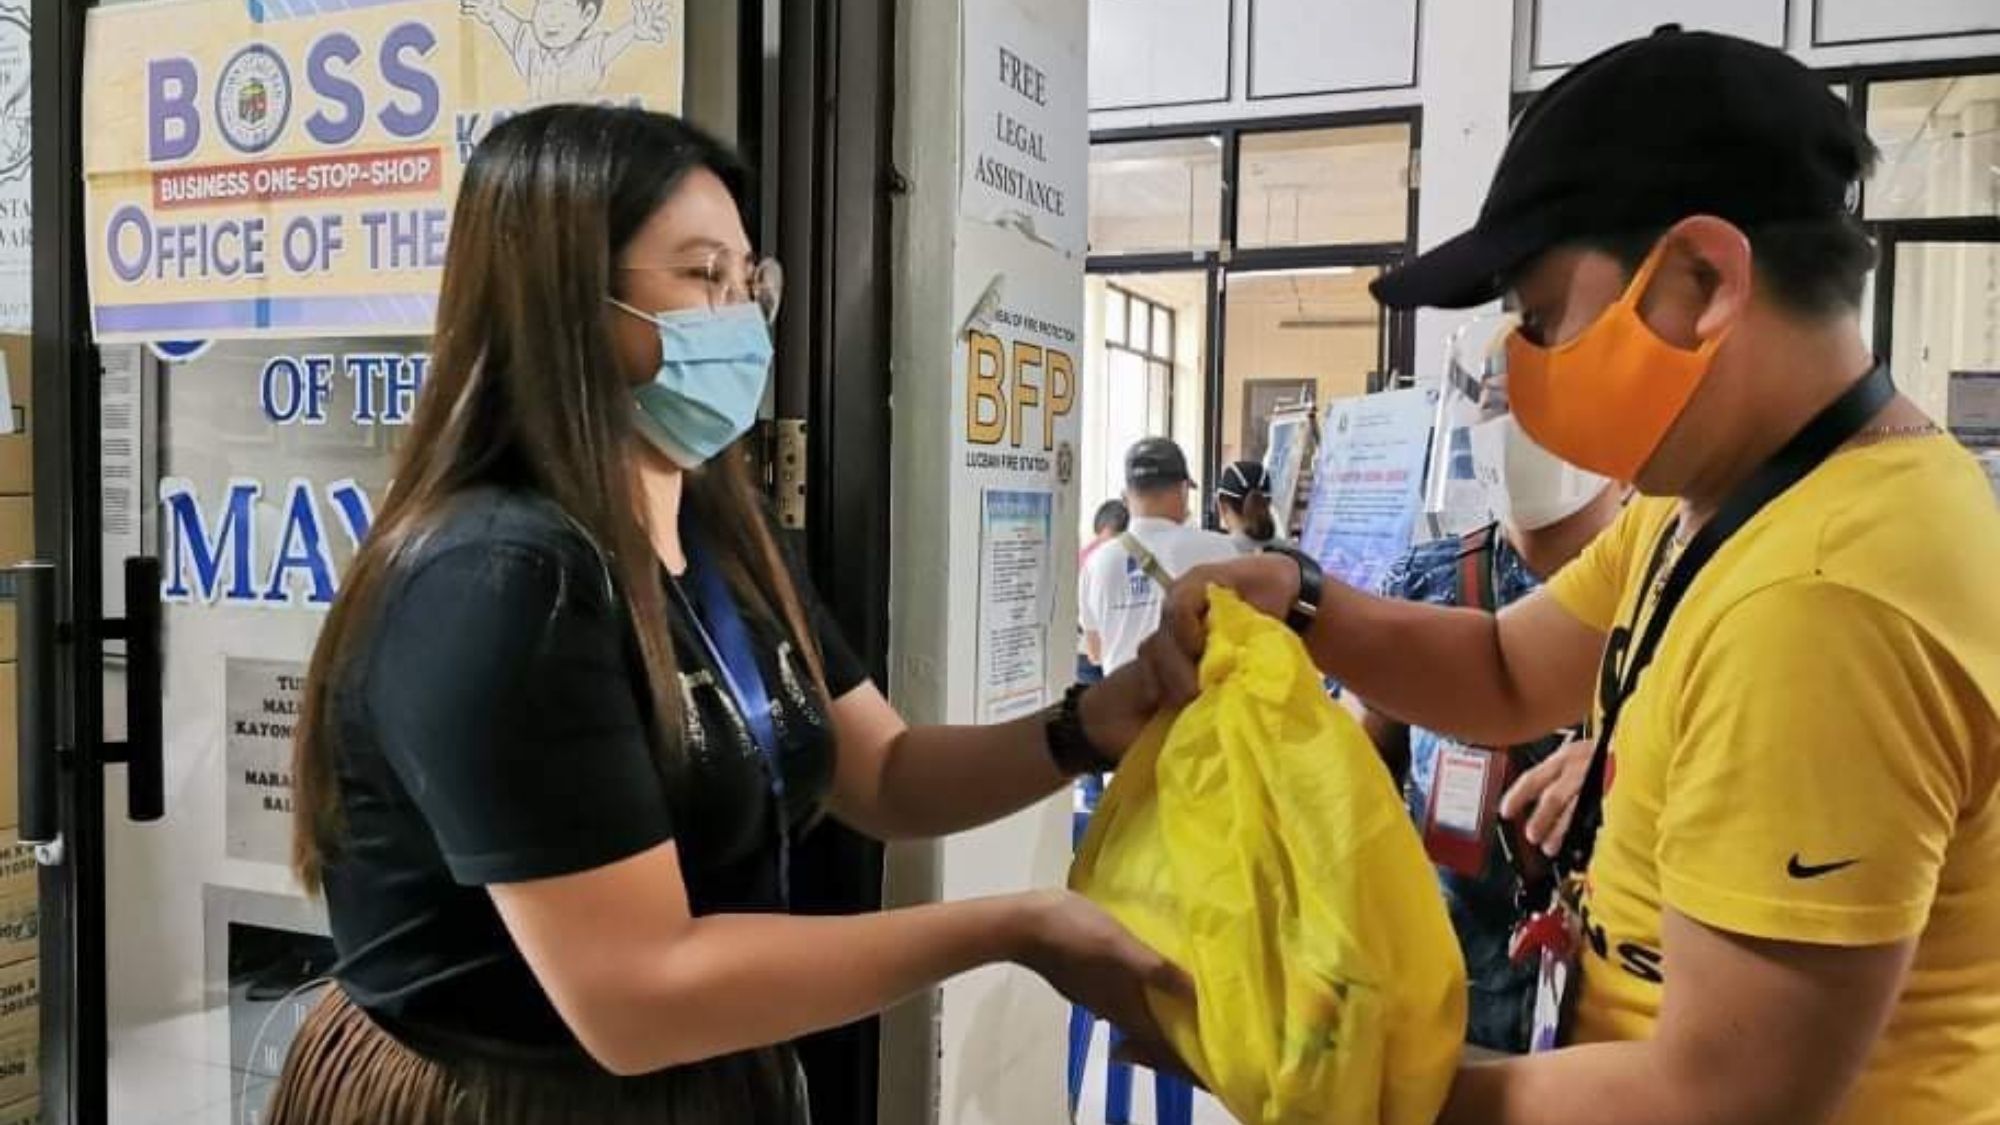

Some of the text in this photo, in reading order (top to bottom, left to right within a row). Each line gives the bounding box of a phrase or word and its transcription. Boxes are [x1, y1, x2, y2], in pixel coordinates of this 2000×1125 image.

[999, 47, 1046, 107] FREE
[996, 111, 1046, 163] LEGAL
[161, 157, 431, 201] BUSINESS ONE-STOP-SHOP
[974, 154, 1065, 217] ASSISTANCE
[107, 204, 447, 283] OFFICE OF THE
[263, 357, 333, 421] OF
[967, 328, 1075, 451] BFP
